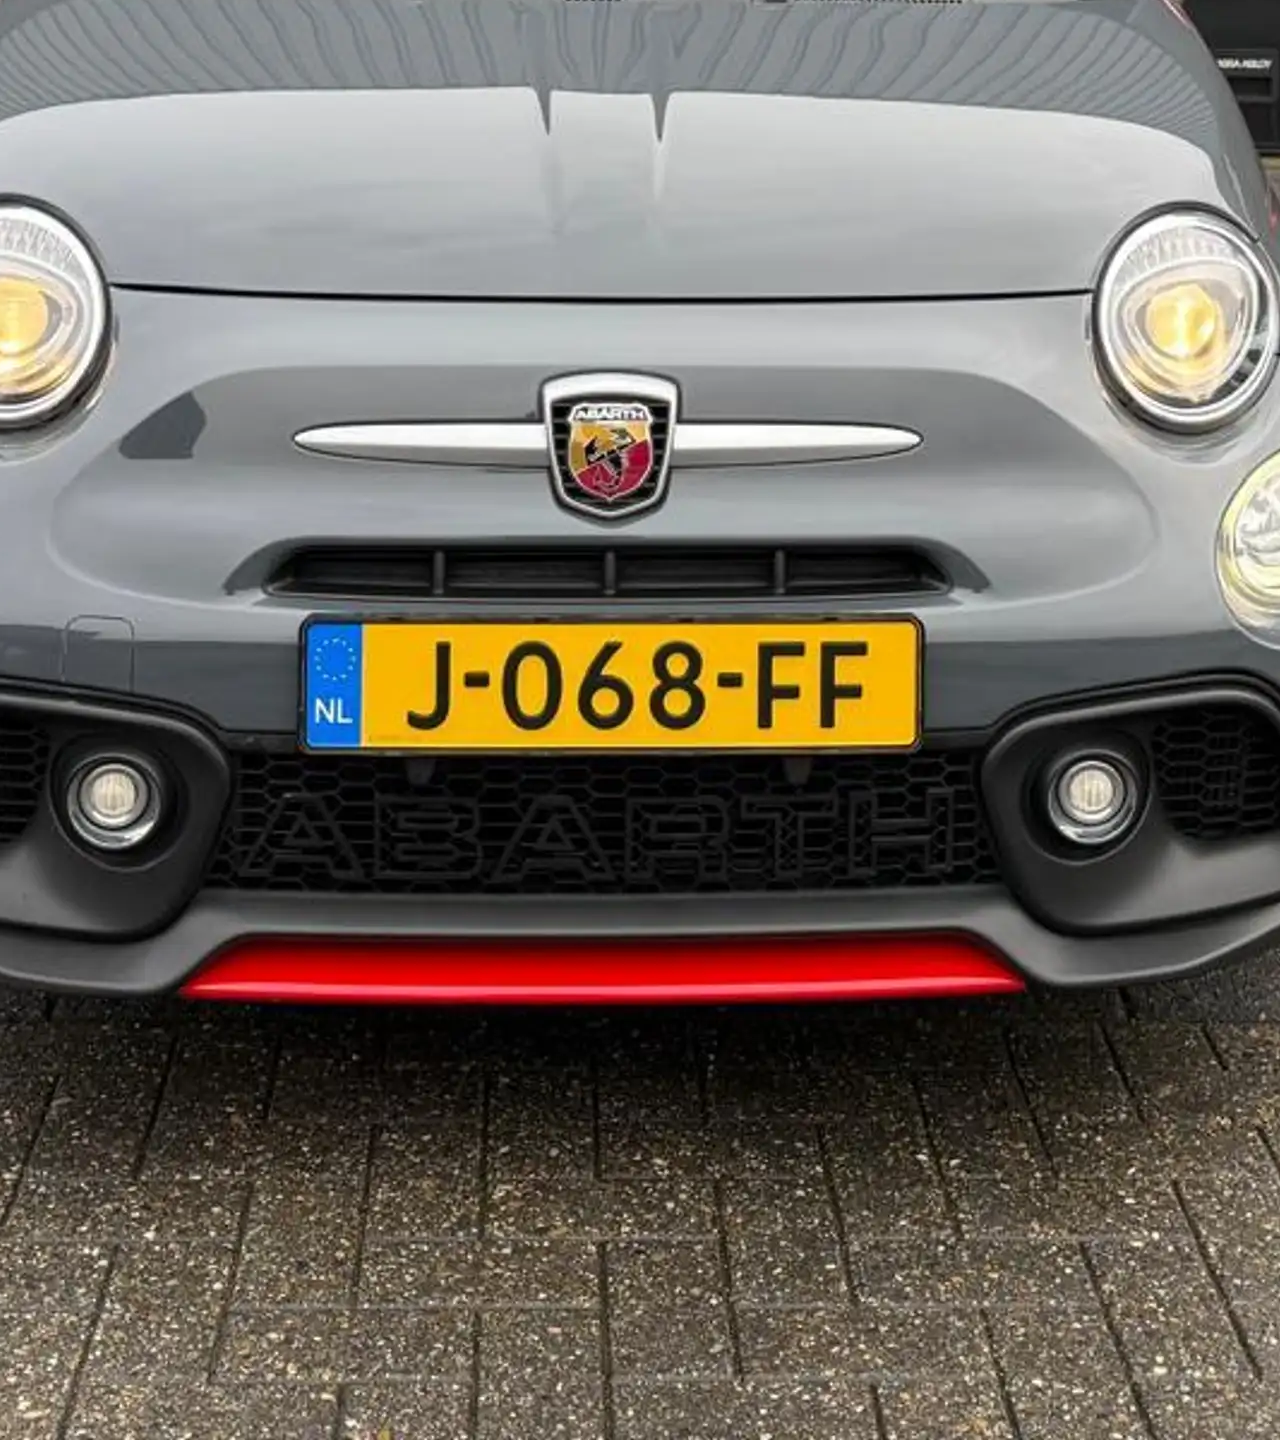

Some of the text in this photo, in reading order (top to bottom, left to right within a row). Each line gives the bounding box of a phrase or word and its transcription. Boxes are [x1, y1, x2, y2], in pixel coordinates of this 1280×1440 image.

[575, 408, 646, 419] ABARTH
[314, 641, 868, 731] NL J-068-FF
[238, 789, 956, 881] ABARTH
